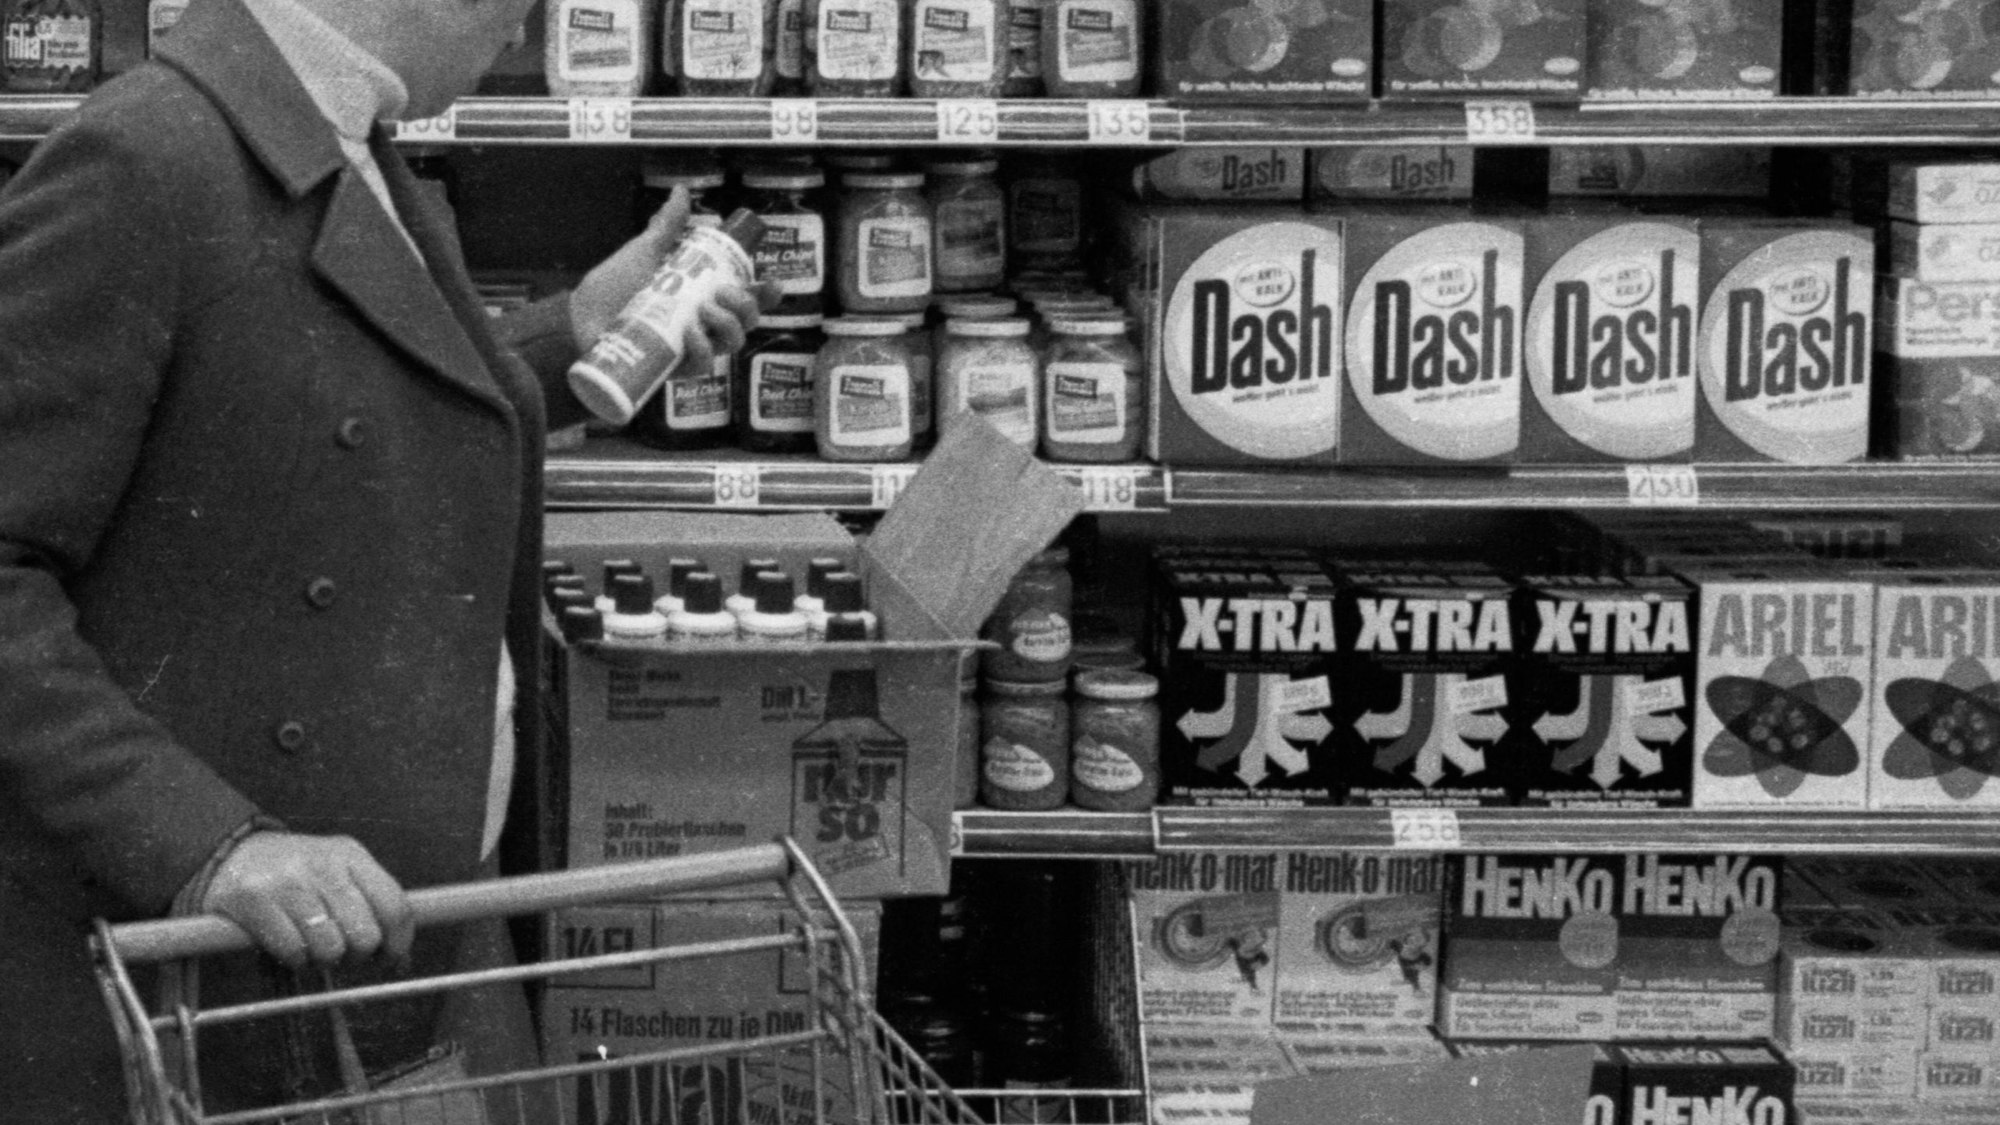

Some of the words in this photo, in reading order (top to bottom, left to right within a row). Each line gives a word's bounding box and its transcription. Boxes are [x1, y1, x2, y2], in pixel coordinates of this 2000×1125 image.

[774, 106, 814, 135] 98
[943, 106, 996, 135] 125
[1094, 106, 1148, 136] 135
[1465, 106, 1530, 135] 358
[1221, 149, 1288, 192] Dash
[1390, 149, 1456, 191] Dash
[1191, 248, 1333, 395] Dash
[1373, 248, 1515, 396] Dash
[1553, 248, 1692, 396] Dash
[1725, 256, 1866, 402] Dash
[718, 472, 757, 500] 88
[1083, 473, 1133, 503] 118
[1177, 597, 1337, 652] X-TRA
[1353, 597, 1513, 652] X-TRA
[1532, 599, 1691, 653] X-TRA
[1707, 593, 1865, 657] ARIEL
[571, 1008, 594, 1035] 14
[601, 1008, 700, 1038] Flaschen
[706, 1016, 733, 1039] zu
[740, 1011, 760, 1038] je
[766, 1011, 804, 1034] DM
